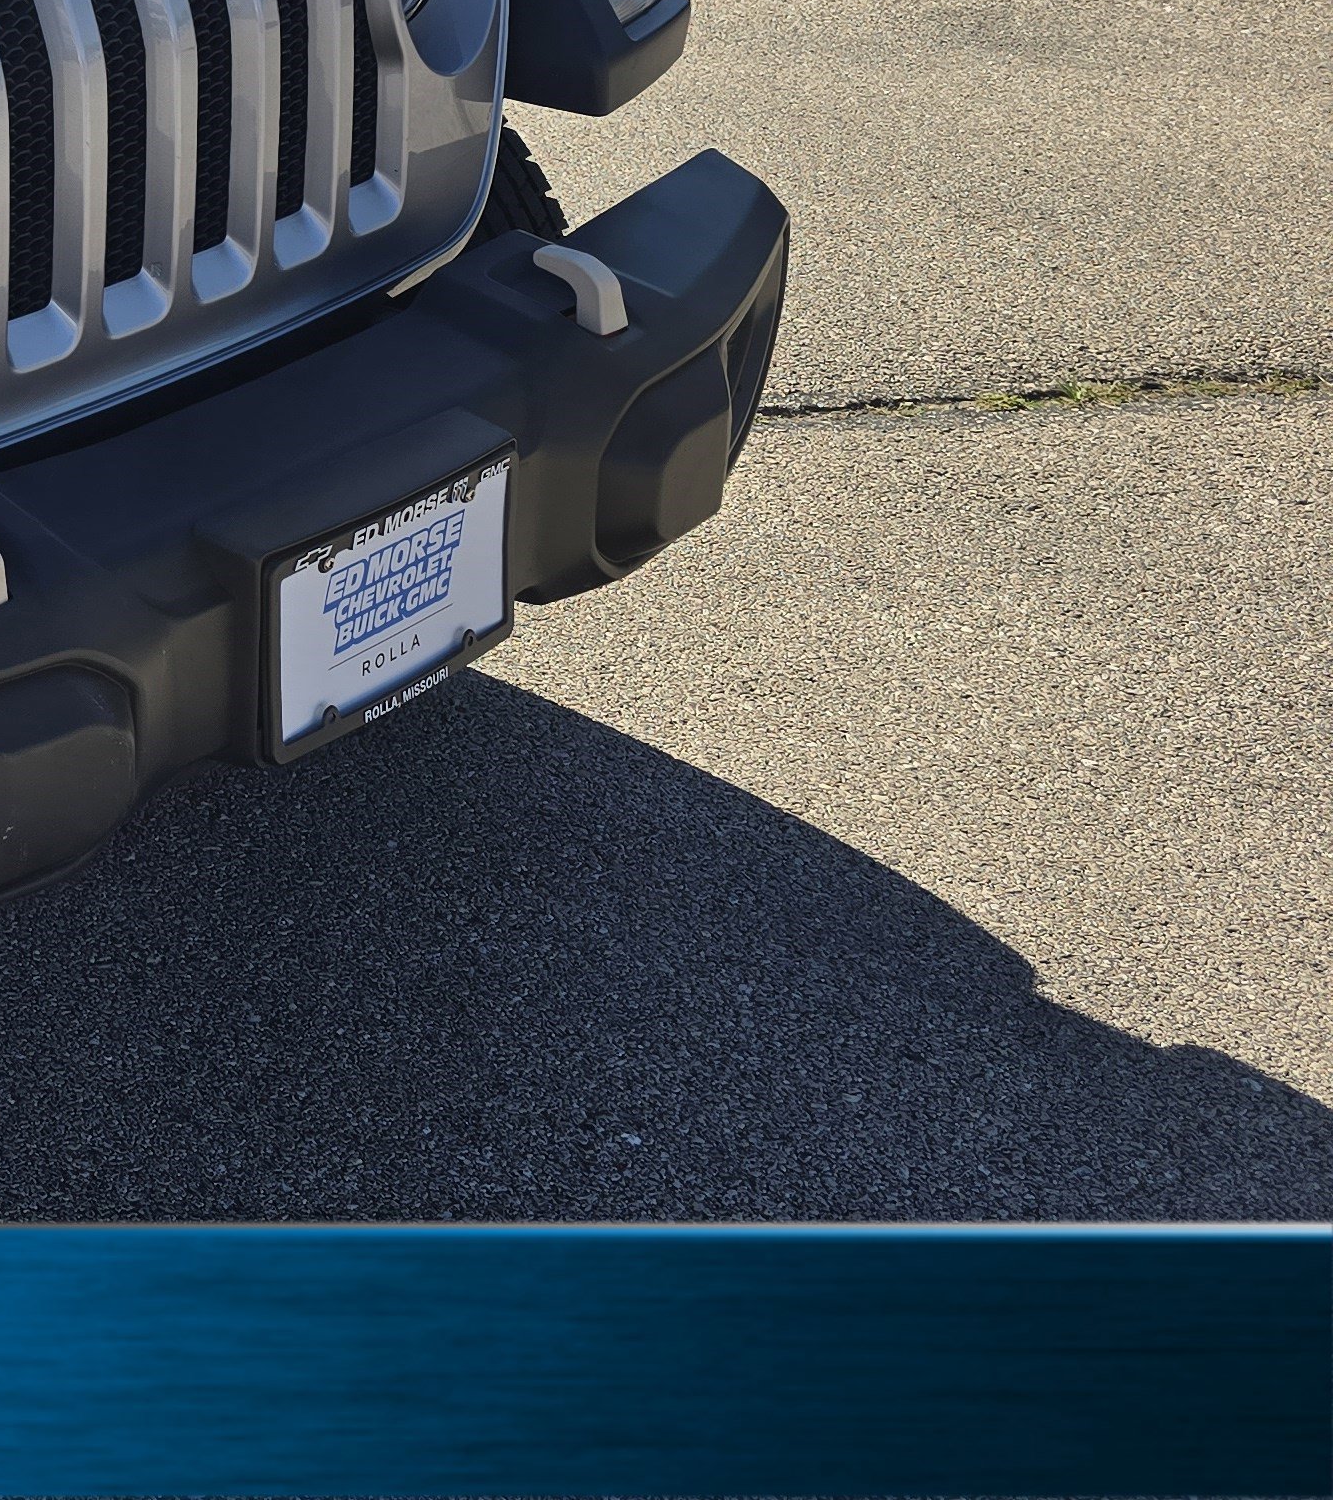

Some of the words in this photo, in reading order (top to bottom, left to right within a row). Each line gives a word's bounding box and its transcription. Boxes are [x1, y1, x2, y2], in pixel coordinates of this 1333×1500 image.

[352, 522, 380, 551] ED
[383, 486, 450, 535] MORSE
[480, 457, 512, 483] GMC
[326, 560, 365, 606] ED
[366, 511, 465, 586] MORSE
[361, 633, 421, 677] ROLLA
[363, 695, 402, 724] ROLLA,
[402, 665, 450, 705] MISSOURI
